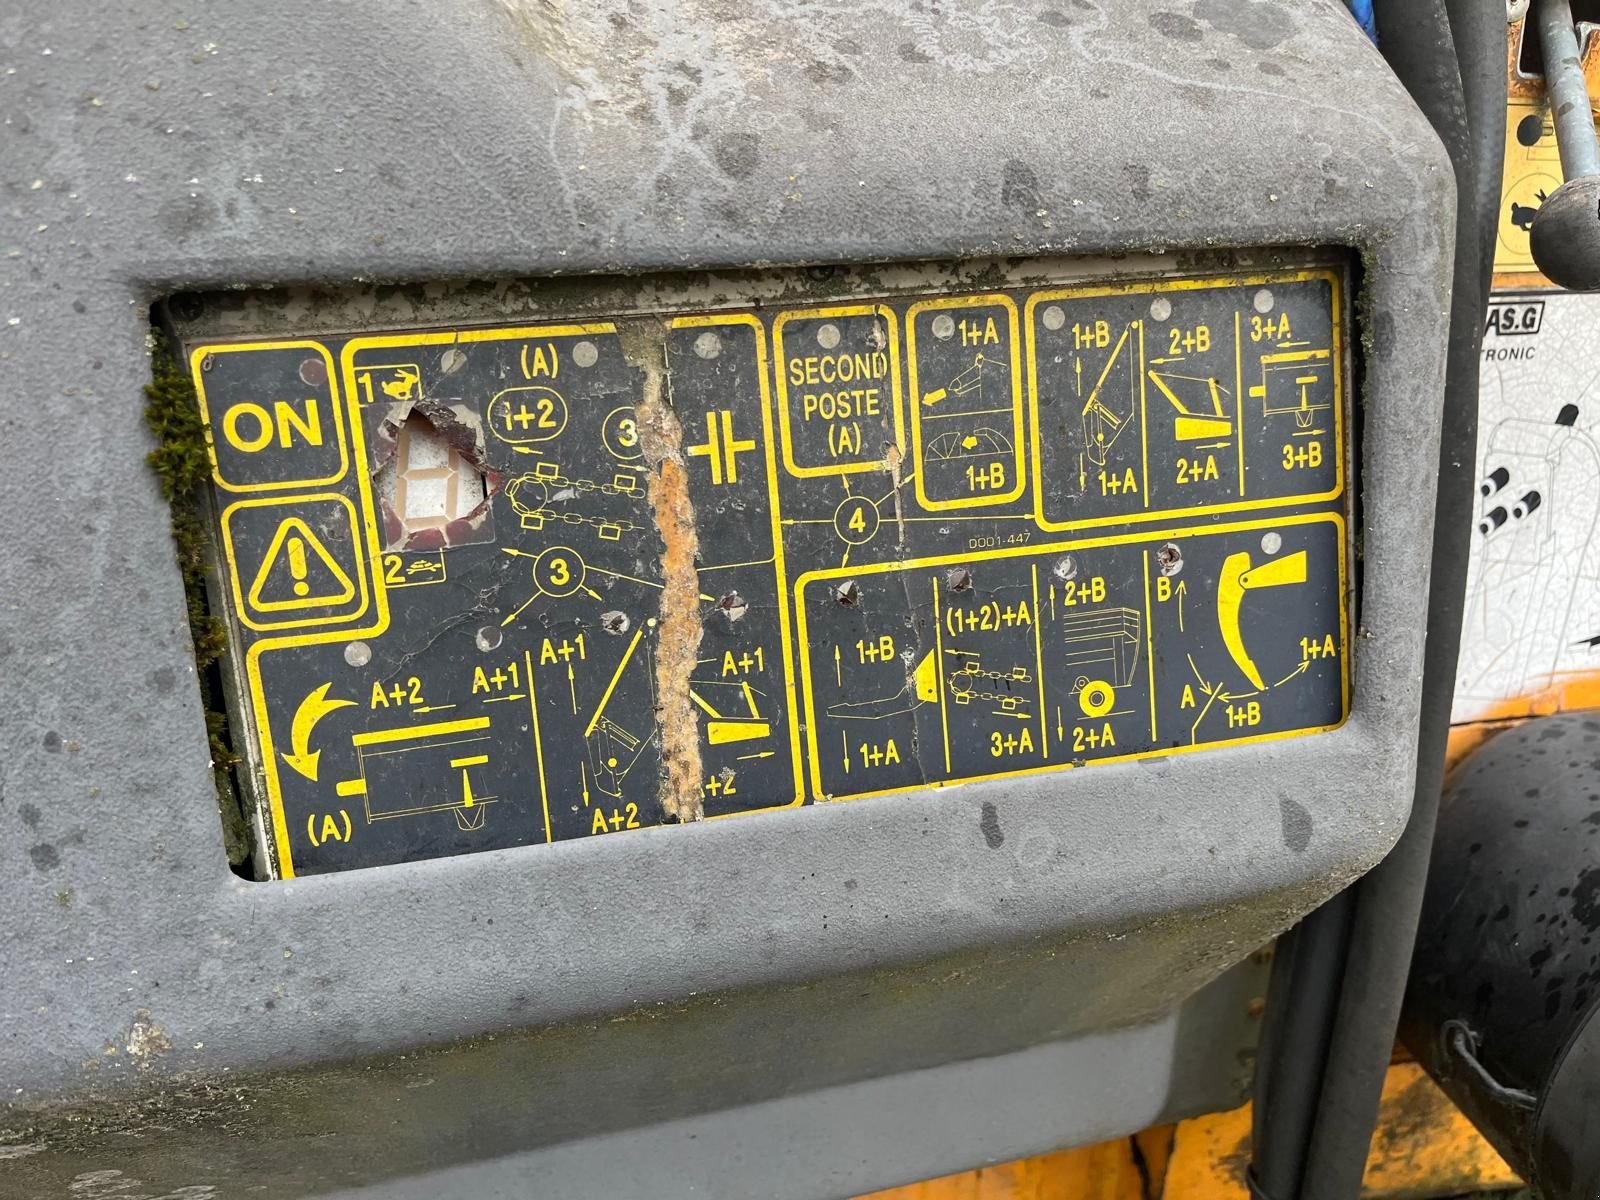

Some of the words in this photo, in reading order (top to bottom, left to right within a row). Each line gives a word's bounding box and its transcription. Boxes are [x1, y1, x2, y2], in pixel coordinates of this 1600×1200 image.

[958, 317, 1000, 347] 1+A
[1072, 320, 1110, 350] 1+B
[1169, 325, 1211, 355] 2+B
[1250, 312, 1292, 342] 3+A
[521, 343, 559, 379] (A)
[1481, 346, 1536, 361] RONIC
[789, 352, 888, 386] SECOND
[357, 372, 374, 403] 1
[504, 398, 557, 431] 1+2
[803, 388, 880, 422] POSTE
[222, 399, 323, 453] ON
[618, 418, 639, 447] 3
[828, 421, 862, 458] (A)
[1175, 455, 1220, 484] 2+A
[1282, 442, 1323, 470] 3+B
[965, 462, 1006, 491] 1+B
[1098, 468, 1138, 497] 1+A
[848, 506, 866, 533] 4
[384, 555, 407, 584] 2
[549, 558, 570, 586] 3
[1063, 576, 1107, 606] 2+B
[1157, 577, 1171, 602] B
[946, 600, 1031, 636] (1+2)+A
[540, 634, 586, 666] A+1
[722, 647, 765, 677] A+1
[856, 636, 895, 664] 1+B
[1300, 634, 1337, 660] 1+A
[472, 662, 520, 694] A+1
[371, 677, 424, 710] A+2
[1181, 685, 1196, 709] A
[1225, 701, 1261, 728] 1+B
[990, 727, 1034, 757] 3+A
[1073, 723, 1116, 752] 2+A
[860, 739, 900, 769] 1+A
[701, 770, 737, 799] +2
[307, 809, 352, 847] (A)
[592, 802, 640, 835] A+2
